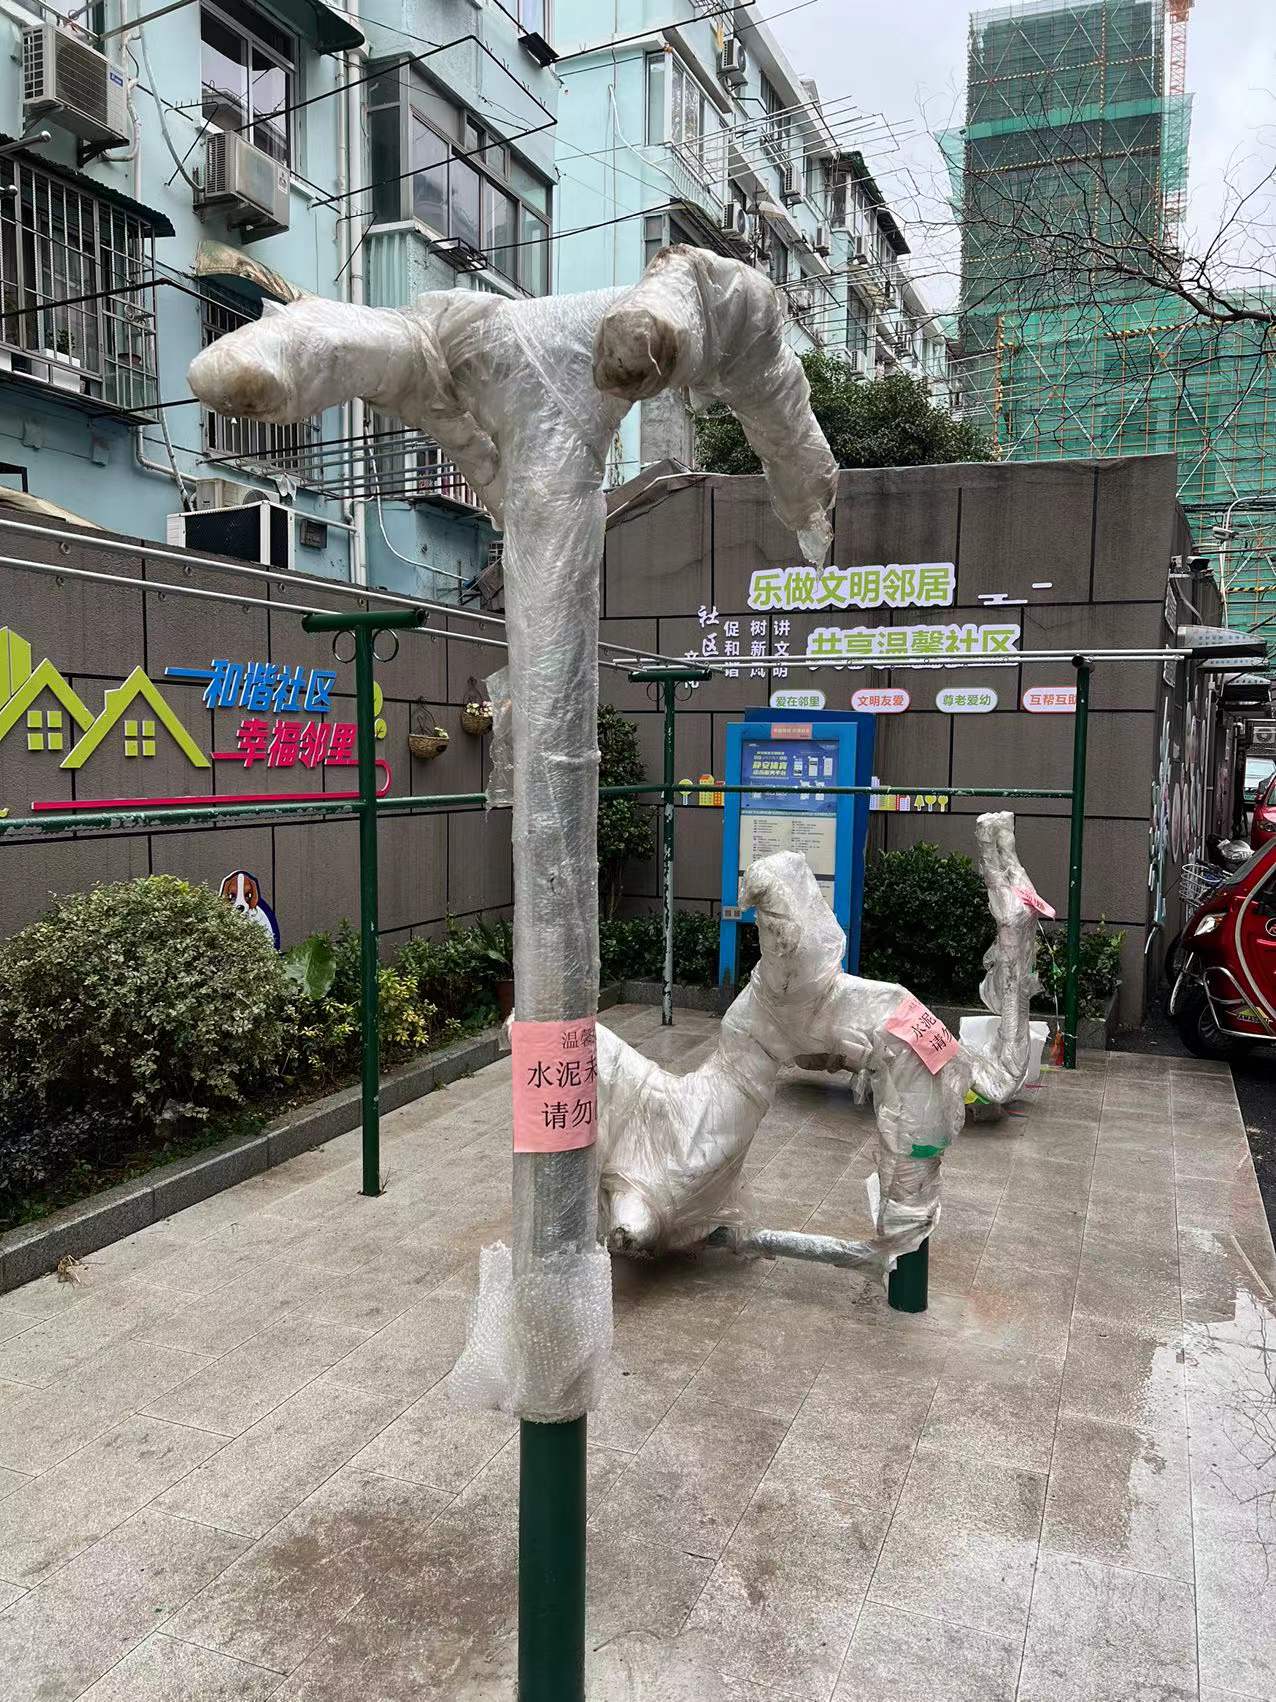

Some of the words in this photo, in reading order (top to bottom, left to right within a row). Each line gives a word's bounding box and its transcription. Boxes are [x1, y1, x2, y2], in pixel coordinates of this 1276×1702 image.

[752, 567, 951, 607] 乐做文明邻居
[697, 605, 720, 657] 社区
[202, 659, 336, 713] 和谐社区
[775, 695, 821, 708] 爱在邻里
[857, 694, 905, 707] 文明友爱
[943, 694, 991, 707] 尊老爱幼
[232, 718, 358, 768] 幸福邻里
[911, 1011, 937, 1040] 水泥
[541, 1098, 598, 1130] 请勿
